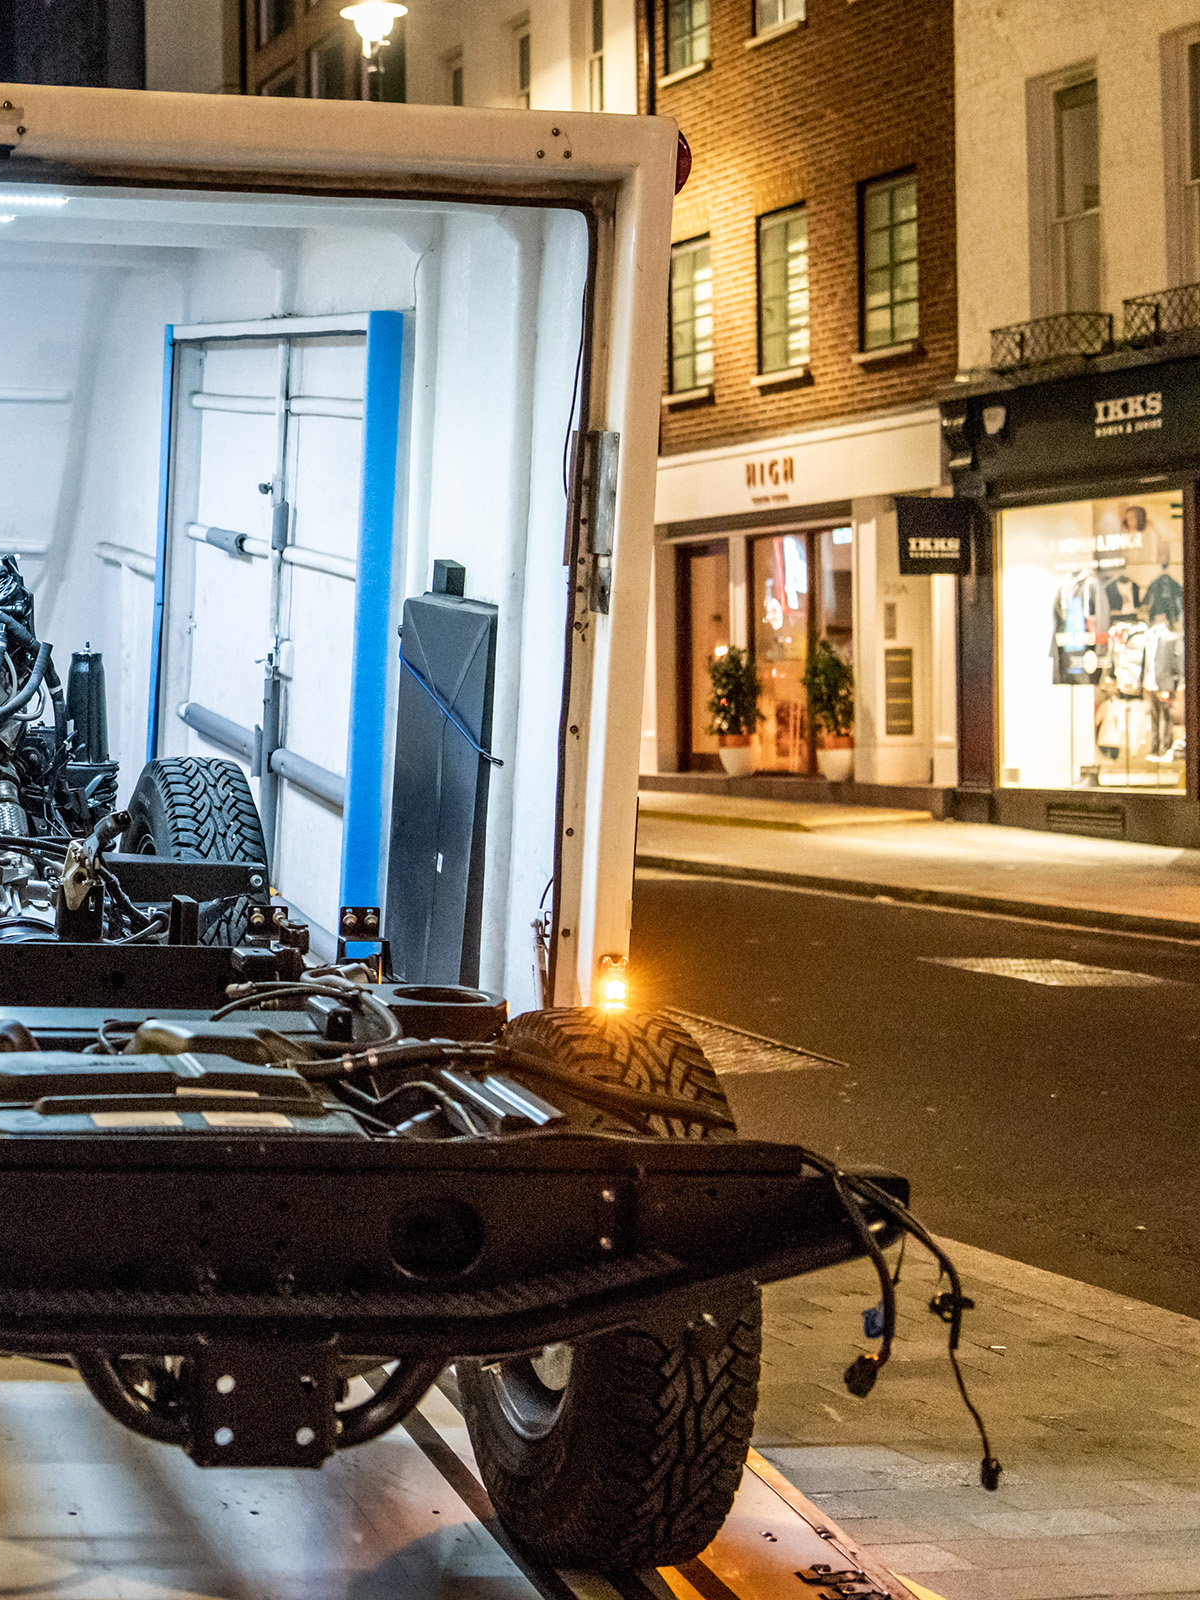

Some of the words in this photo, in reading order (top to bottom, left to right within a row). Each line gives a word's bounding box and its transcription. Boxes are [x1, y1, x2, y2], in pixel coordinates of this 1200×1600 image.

[1095, 391, 1162, 424] IKKS
[745, 456, 795, 489] HIGH
[908, 537, 961, 552] IKKS
